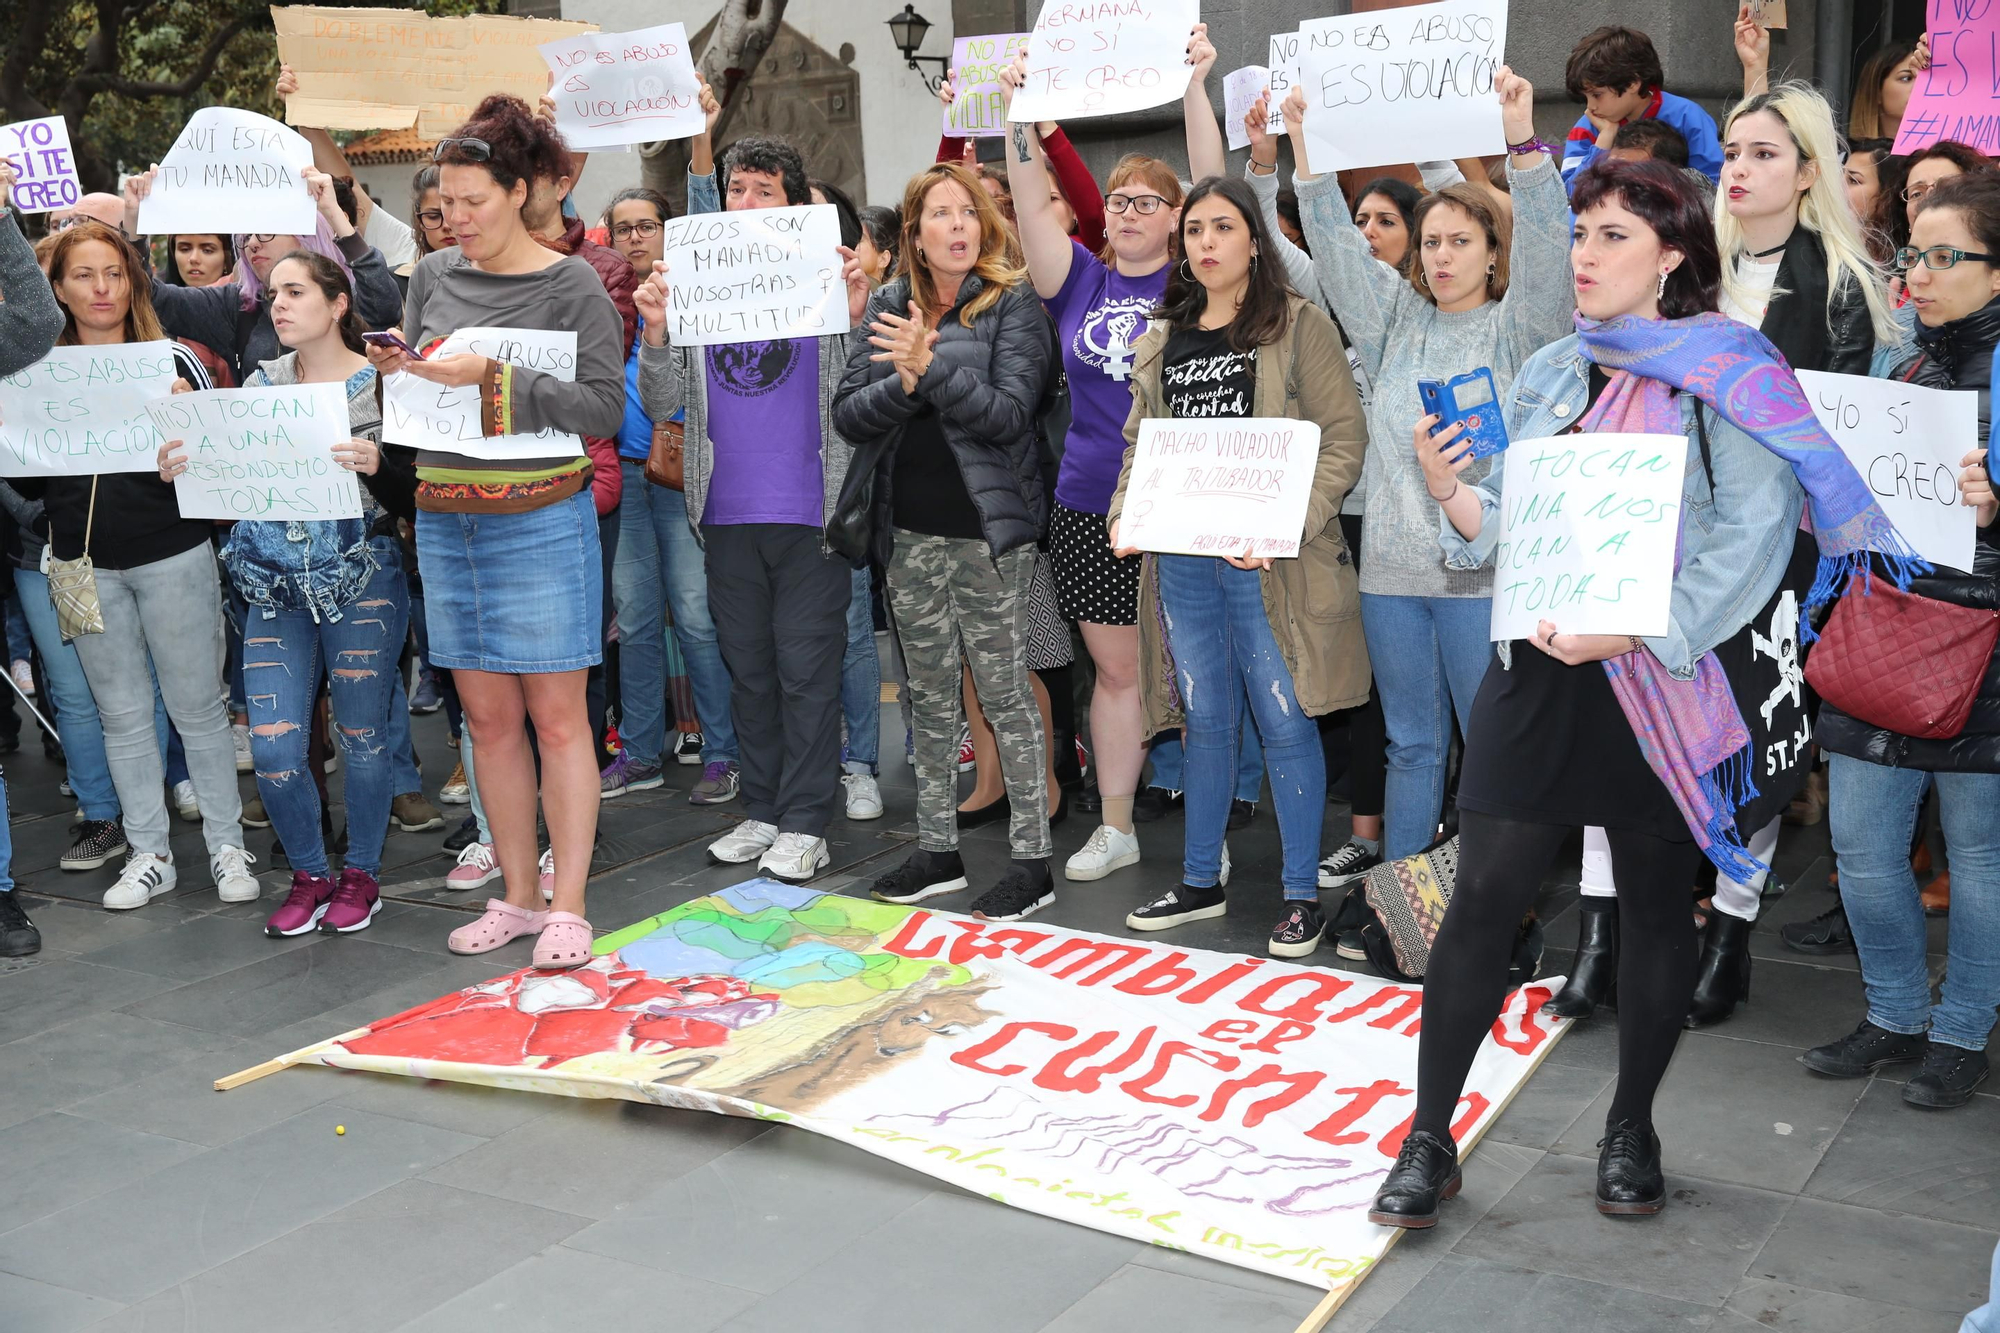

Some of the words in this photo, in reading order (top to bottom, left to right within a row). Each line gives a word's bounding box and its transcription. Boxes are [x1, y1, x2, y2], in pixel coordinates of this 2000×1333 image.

[1045, 38, 1076, 52] YO
[1310, 29, 1344, 51] NO
[1408, 14, 1494, 46] ABUSO
[555, 50, 588, 68] NO
[594, 51, 616, 64] ES
[966, 40, 996, 61] NO
[1271, 35, 1298, 65] NO
[1923, 28, 1974, 97] ES
[564, 74, 591, 93] ES
[1031, 66, 1071, 95] TE
[1085, 64, 1161, 90] CREO
[1270, 69, 1289, 91] ES
[1321, 63, 1372, 108] ES
[10, 122, 53, 149] YO
[175, 122, 218, 153] QUÍ
[232, 127, 285, 152] ESTA
[37, 147, 73, 176] TE
[158, 165, 188, 192] TU
[204, 163, 293, 190] MANADA
[12, 178, 78, 210] CREO
[666, 220, 740, 251] ELLOS
[762, 211, 812, 233] SON
[693, 238, 803, 273] MANADA
[672, 274, 797, 310] NOSOTRAS
[42, 361, 81, 383] ES
[86, 357, 175, 387] ABUSO
[1167, 361, 1246, 386] rebeldía
[744, 384, 779, 398] NUESTRA
[42, 397, 91, 422] ES
[210, 394, 316, 424] TOCAN
[1819, 391, 1861, 431] YO
[1887, 401, 1911, 434] SÍ
[198, 435, 217, 454] A
[229, 424, 295, 451] UNA
[1149, 430, 1208, 457] MACHO
[1216, 430, 1293, 462] VIOLADOR
[1141, 467, 1164, 491] AL
[1529, 449, 1671, 482] TOCAN
[1868, 452, 1957, 506] CREO
[207, 485, 318, 514] TODAS
[1508, 491, 1566, 532] UNA
[1584, 492, 1678, 524] NOS
[1497, 535, 1572, 570] OCAN
[1596, 530, 1631, 555] A
[1504, 573, 1638, 616] TODAS
